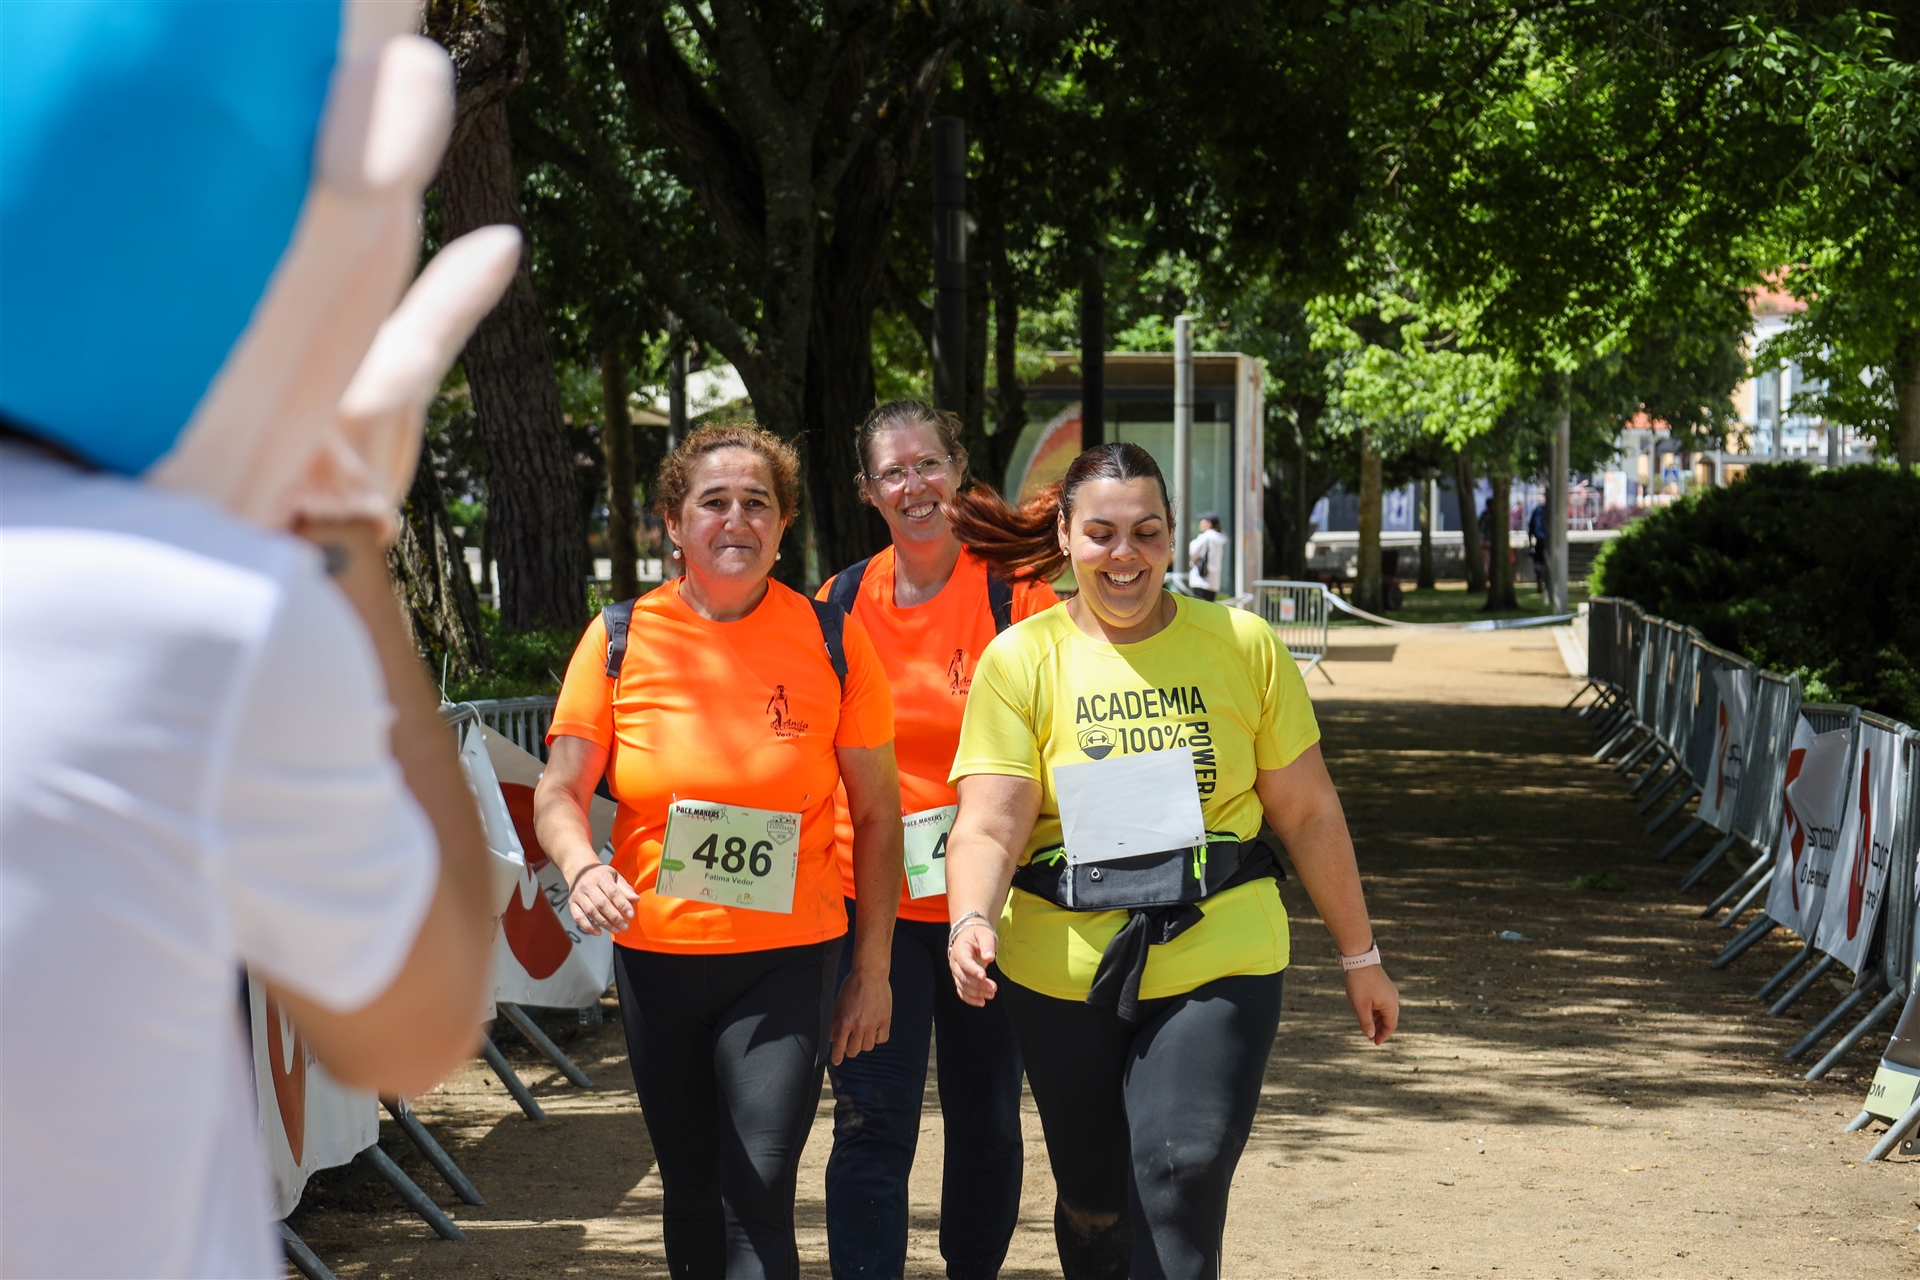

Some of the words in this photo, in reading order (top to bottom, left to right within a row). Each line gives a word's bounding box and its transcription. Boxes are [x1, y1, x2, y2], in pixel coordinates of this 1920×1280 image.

[1076, 686, 1207, 724] ACADEMIA
[1118, 724, 1187, 754] 100%
[675, 806, 693, 815] PACE
[694, 808, 720, 819] MAKERS
[692, 833, 773, 877] 486
[704, 872, 730, 883] Fatima
[732, 876, 754, 886] Vedor
